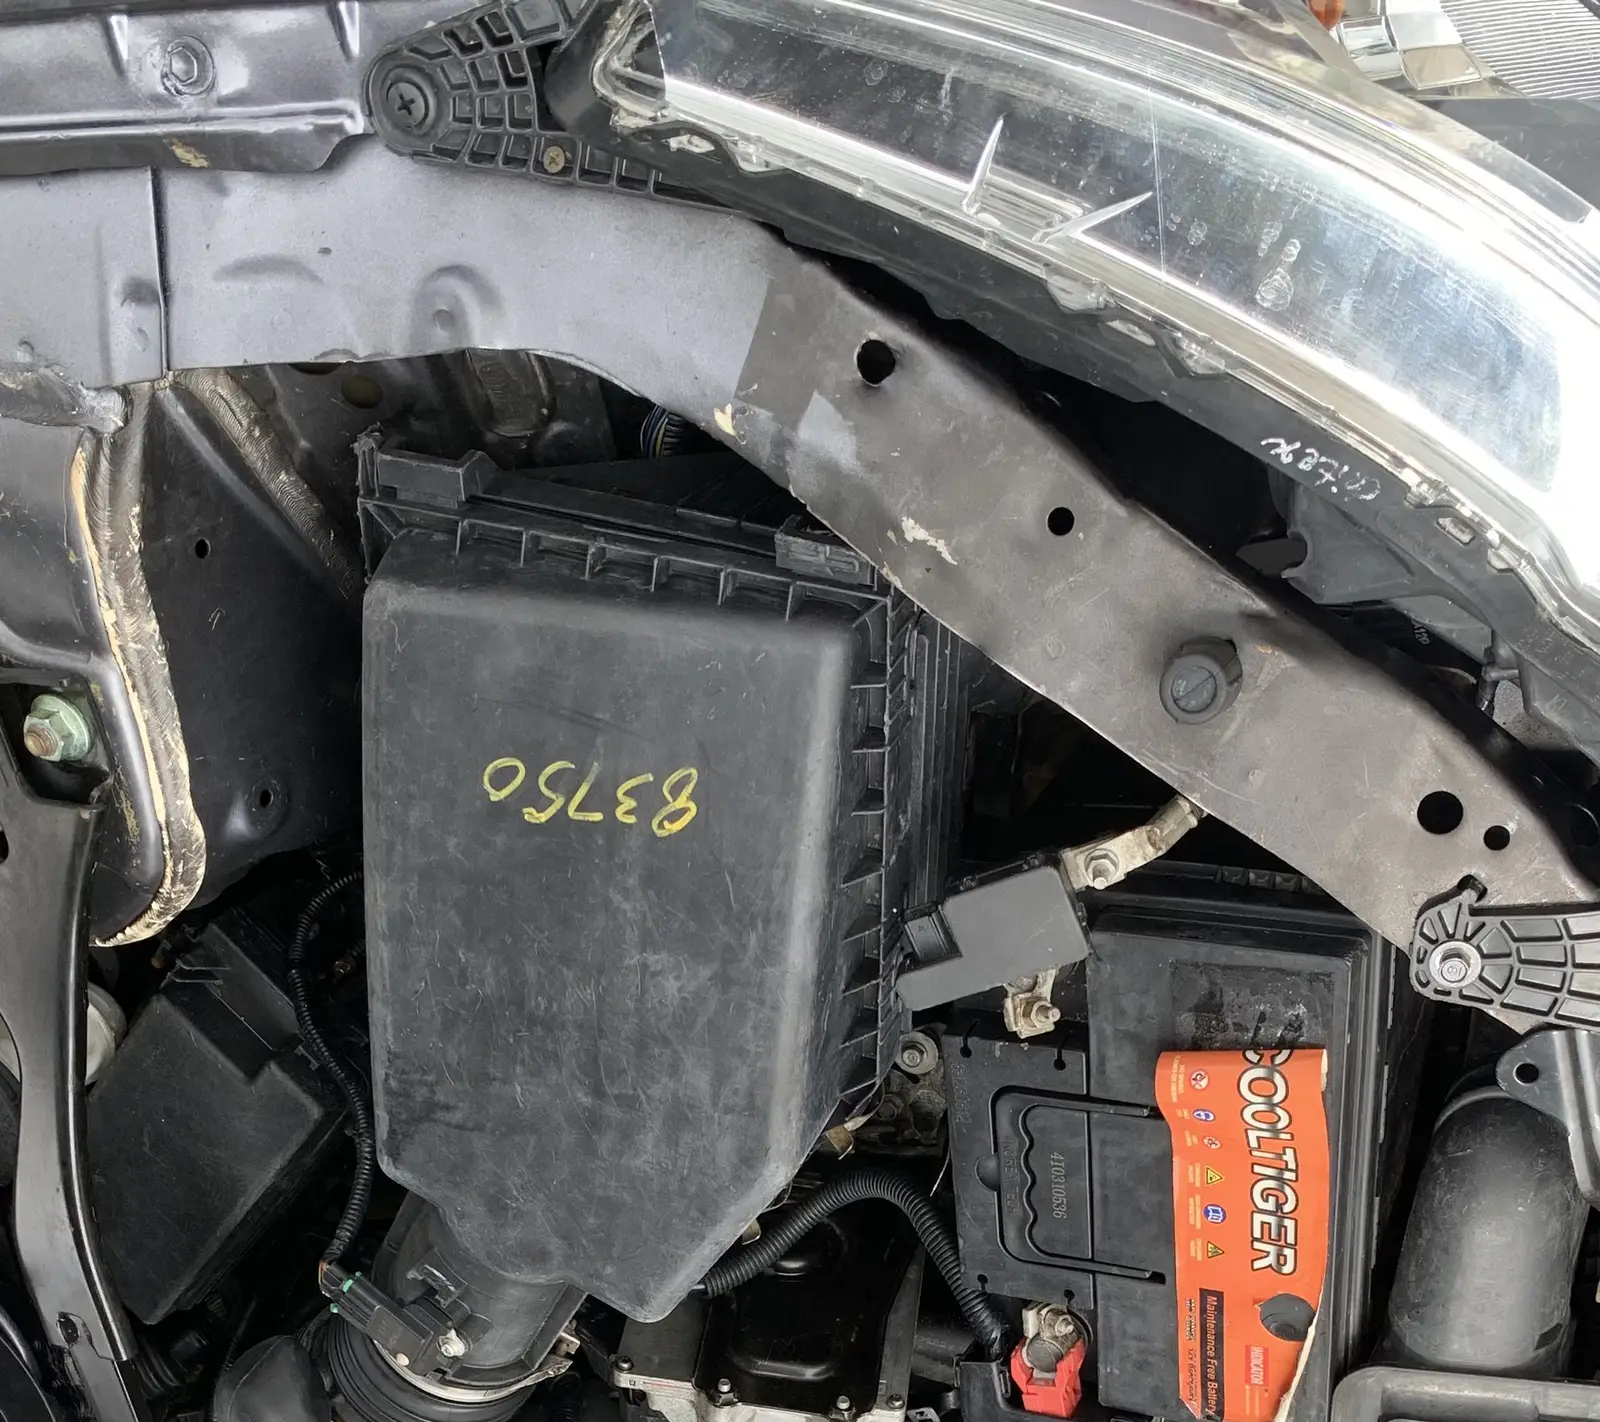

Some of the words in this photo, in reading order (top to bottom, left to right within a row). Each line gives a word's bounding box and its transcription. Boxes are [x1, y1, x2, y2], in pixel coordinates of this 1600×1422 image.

[483, 757, 698, 837] 83750
[1051, 1152, 1068, 1219] 410310536
[1205, 1295, 1218, 1358] Maintenance
[1206, 1358, 1218, 1380] Free
[1251, 1346, 1264, 1385] INDICATOR
[1205, 1381, 1218, 1416] Battery
